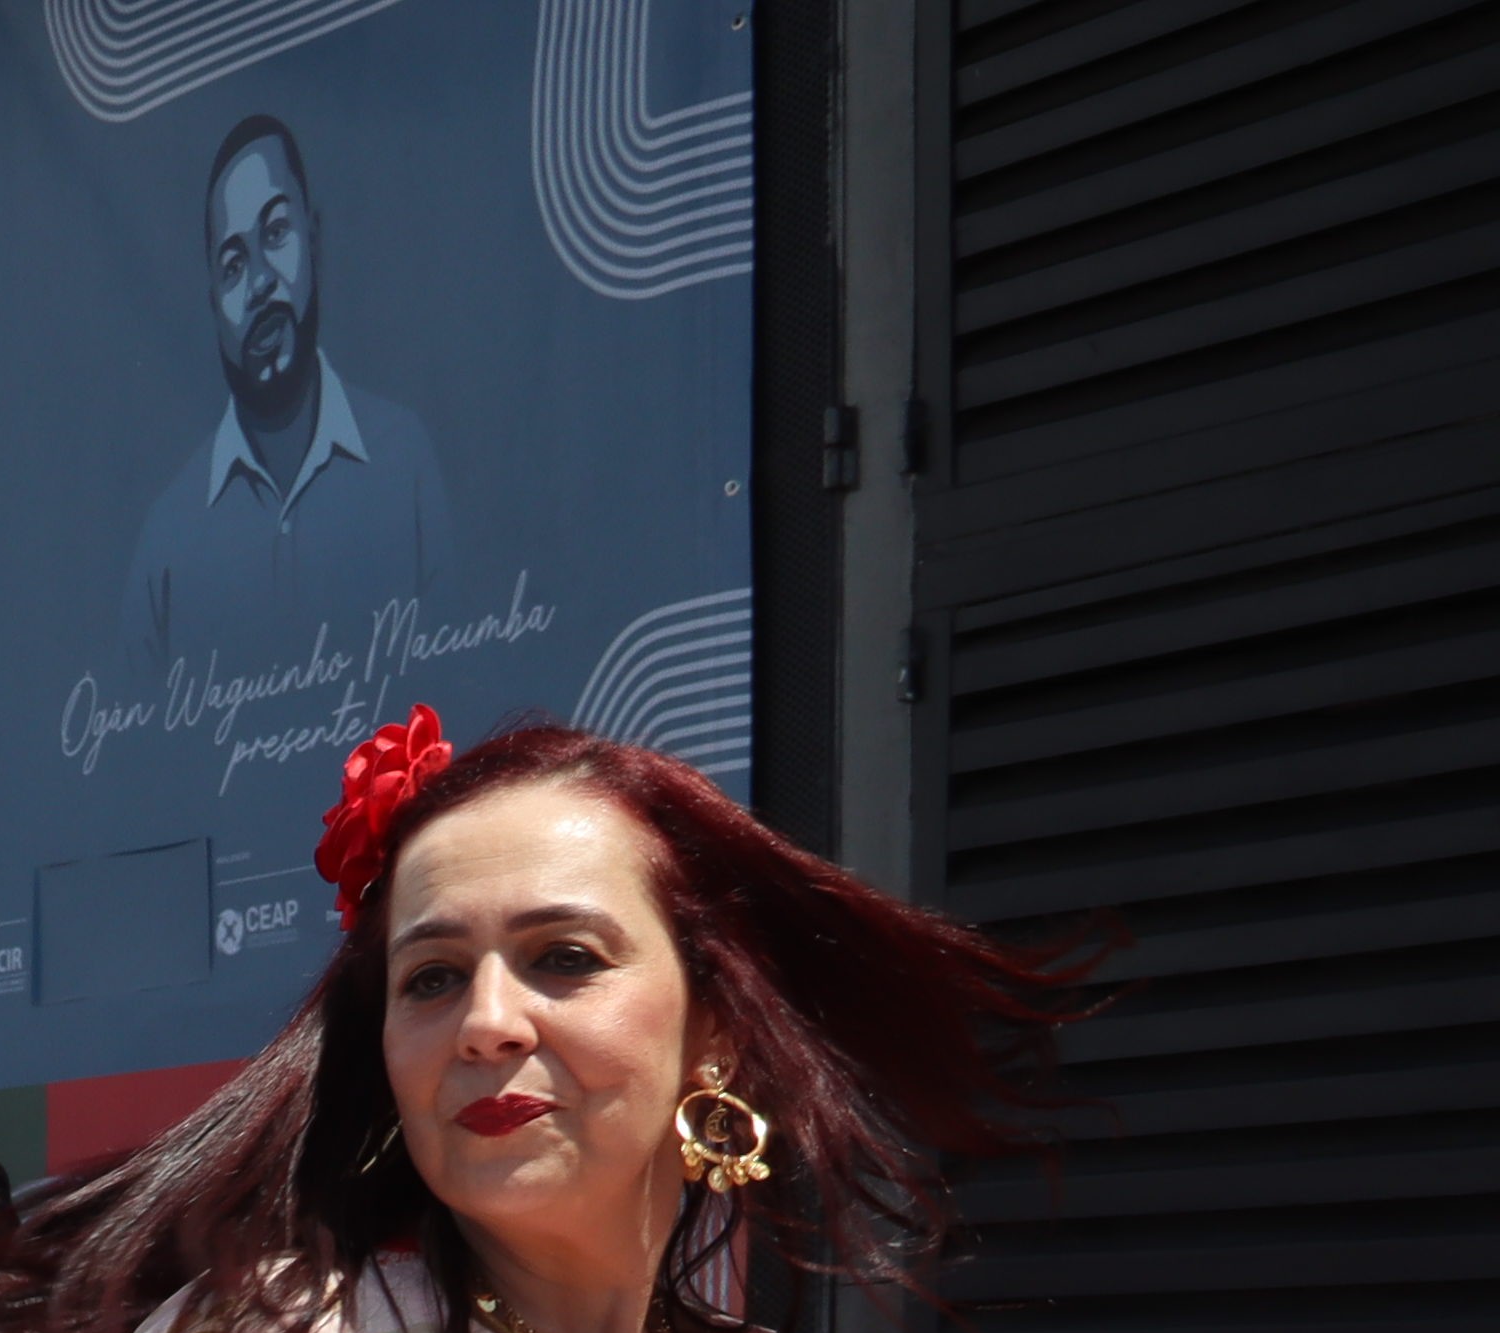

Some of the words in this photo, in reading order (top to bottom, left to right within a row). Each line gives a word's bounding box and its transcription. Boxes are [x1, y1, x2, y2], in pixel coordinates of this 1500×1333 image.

[165, 621, 353, 746] Waguinho
[364, 569, 556, 684] Macumba
[245, 900, 299, 932] CEAP
